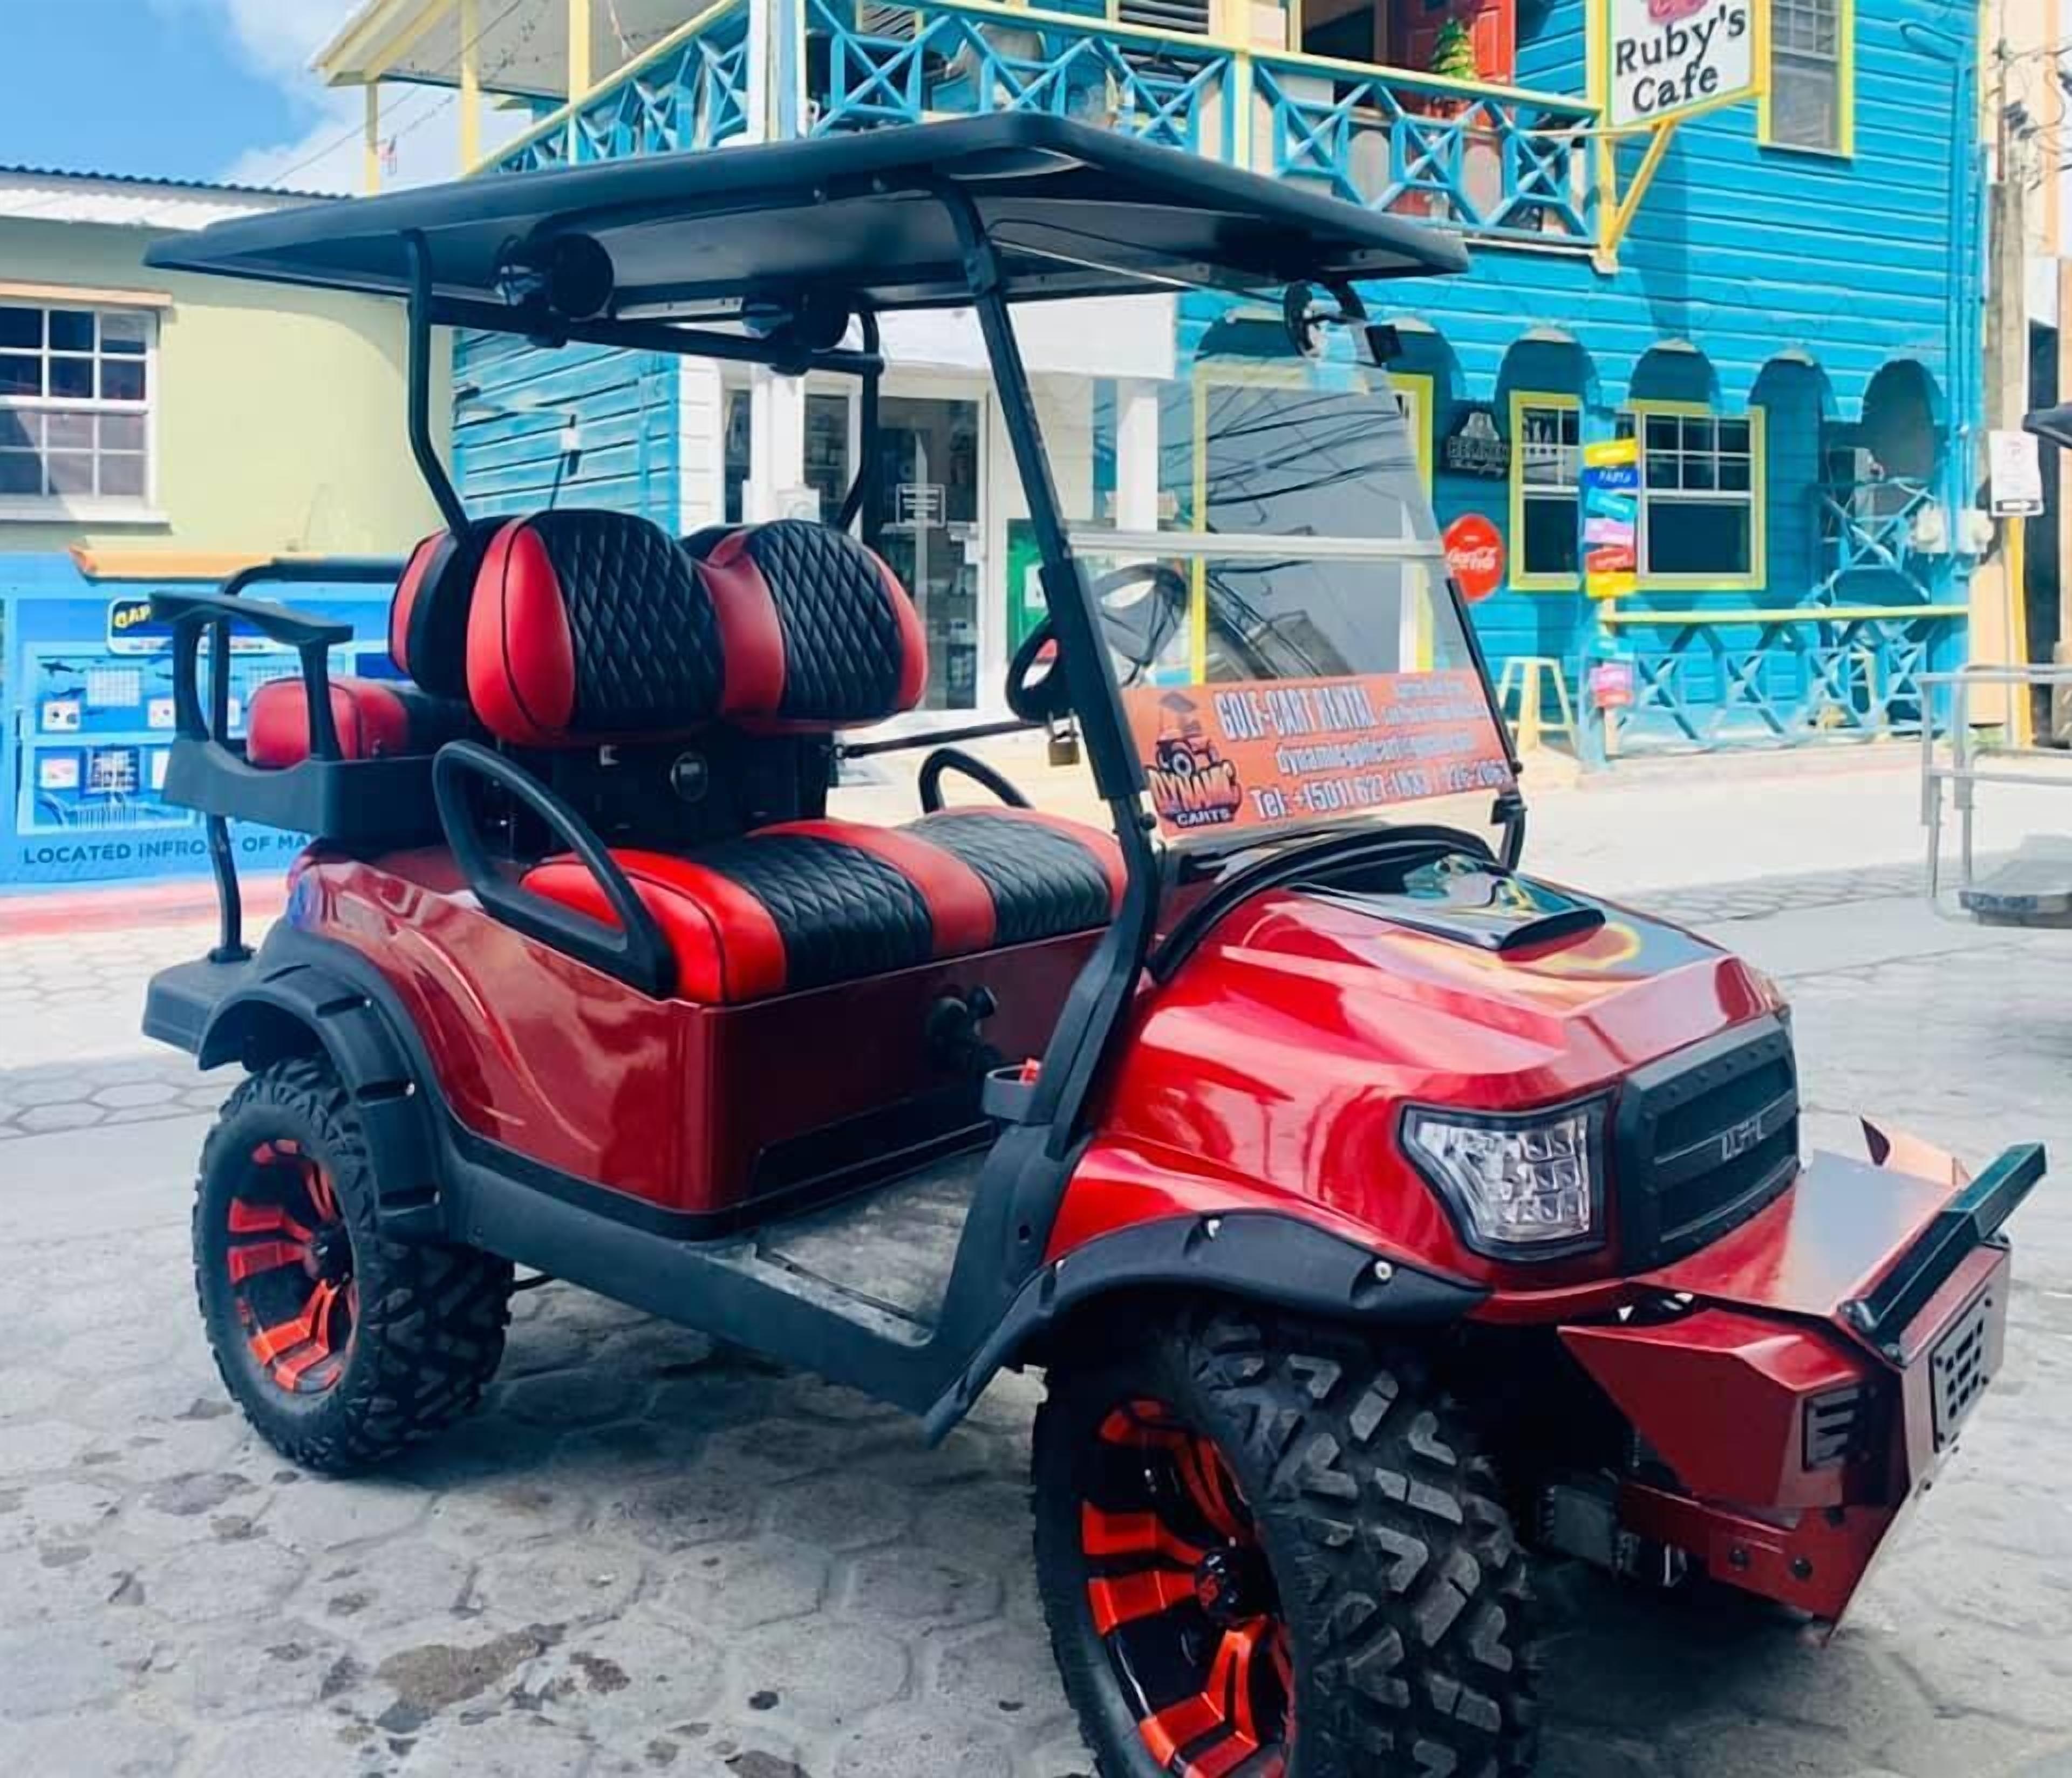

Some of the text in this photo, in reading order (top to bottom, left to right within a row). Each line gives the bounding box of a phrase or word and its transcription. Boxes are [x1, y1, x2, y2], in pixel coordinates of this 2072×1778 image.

[1616, 5, 1746, 76] Ruby's
[1632, 61, 1718, 113] Cafe
[24, 835, 309, 864] LOCATED INFRO OF MA
